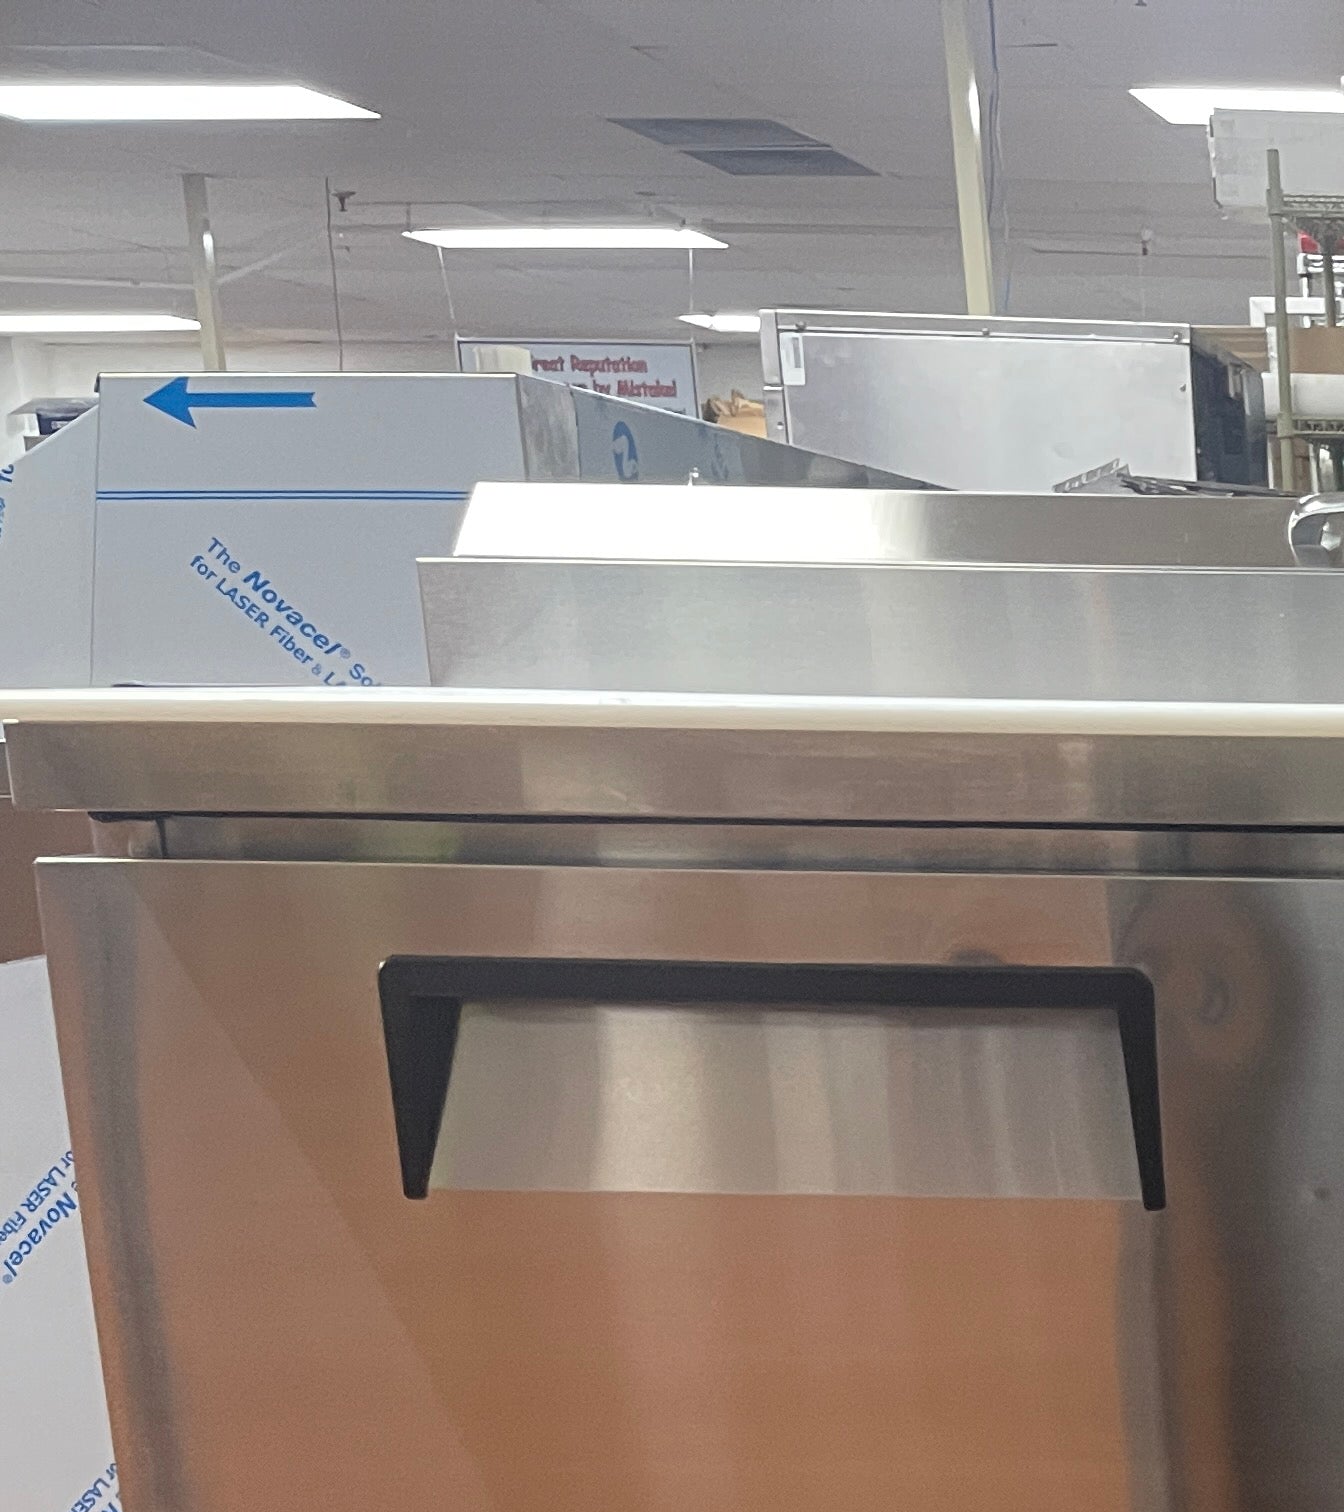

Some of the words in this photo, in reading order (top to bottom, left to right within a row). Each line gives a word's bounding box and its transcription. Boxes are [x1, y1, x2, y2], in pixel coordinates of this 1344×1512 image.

[207, 536, 241, 574] The
[190, 555, 218, 581] for
[215, 577, 270, 629] LASER
[269, 624, 314, 664] Fiber
[20, 1165, 67, 1213] LASER
[0, 1210, 27, 1246] Fibe
